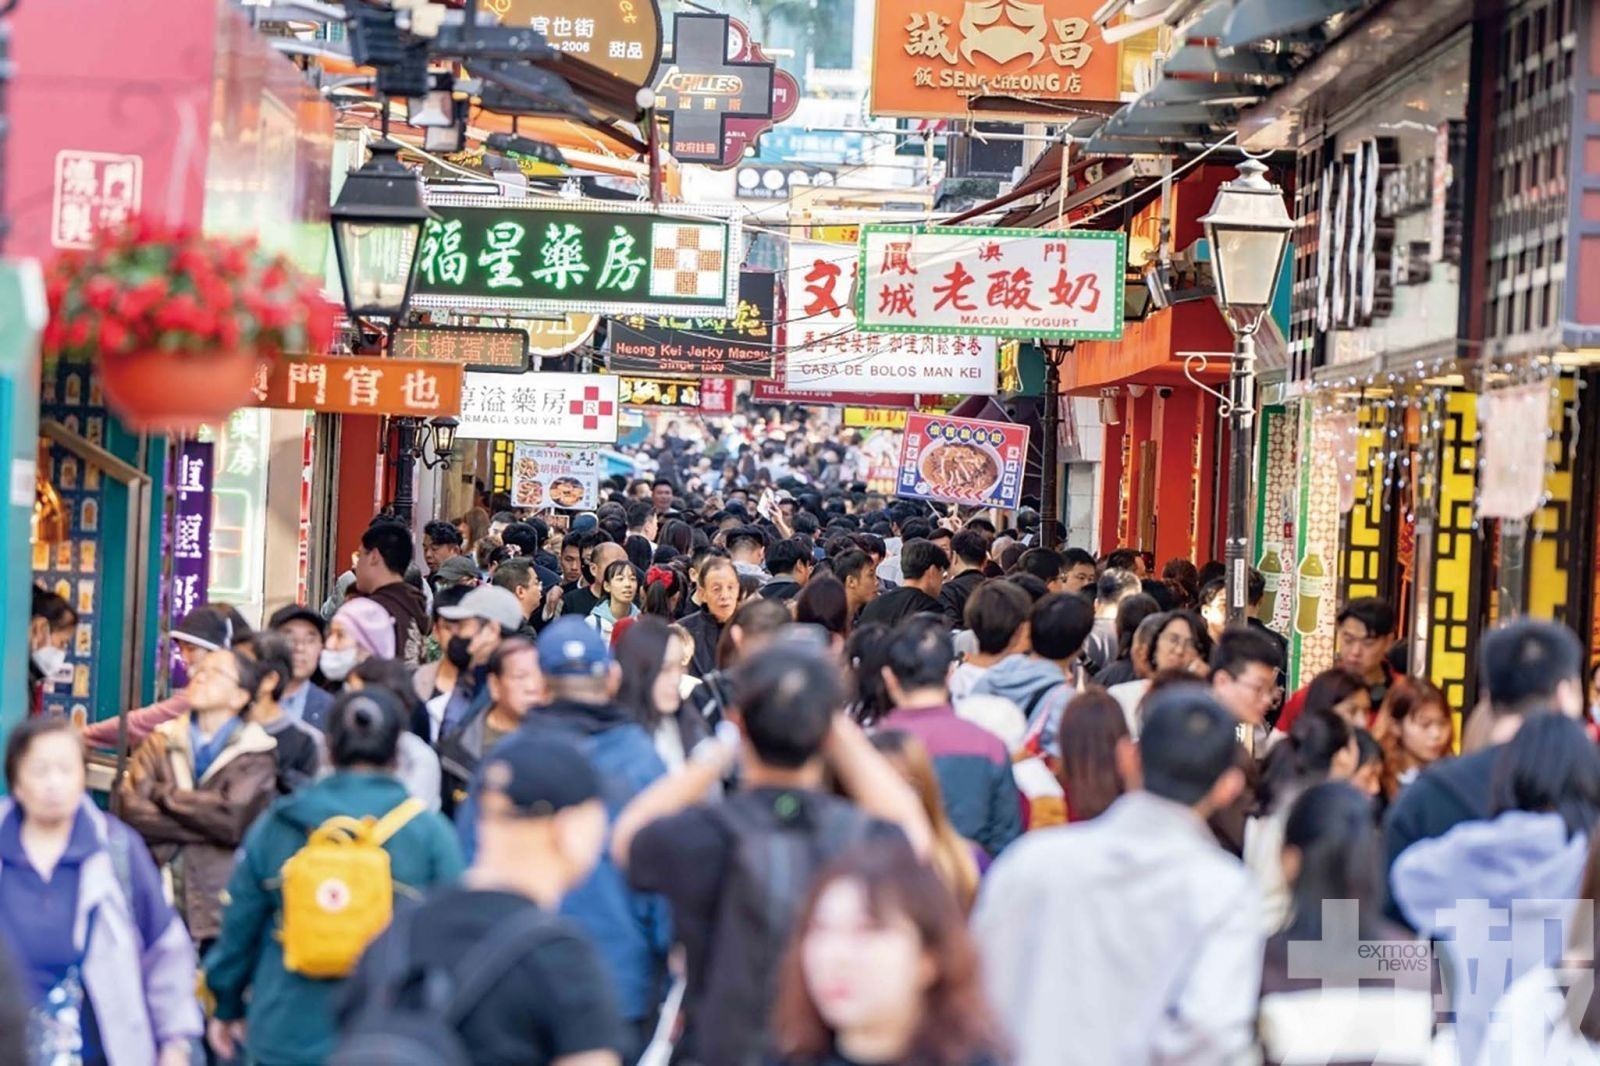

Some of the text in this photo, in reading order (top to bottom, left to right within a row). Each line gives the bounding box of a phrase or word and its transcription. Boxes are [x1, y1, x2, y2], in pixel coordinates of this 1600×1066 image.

[530, 16, 595, 38] 官也街
[904, 11, 1093, 69] 誠 昌
[608, 41, 643, 59] 甜品
[655, 66, 743, 94] ACHILLES
[913, 66, 937, 87] 飯
[990, 73, 1061, 93] CHEONG
[1064, 73, 1081, 93] 店
[420, 217, 647, 293] 福星藥房
[979, 241, 1066, 262] 澳門
[804, 259, 858, 318] 文
[879, 241, 917, 318] 鳳城
[933, 262, 1101, 313] 老酸奶
[960, 315, 1079, 328] MACAU YOGURT
[403, 332, 513, 363] 木糠蛋糕
[615, 342, 769, 360] Heong Kei Jerky Macau
[802, 364, 982, 379] CASA DE BOLOS MAN KEI
[457, 414, 563, 426] ARMACIA SUN YAT
